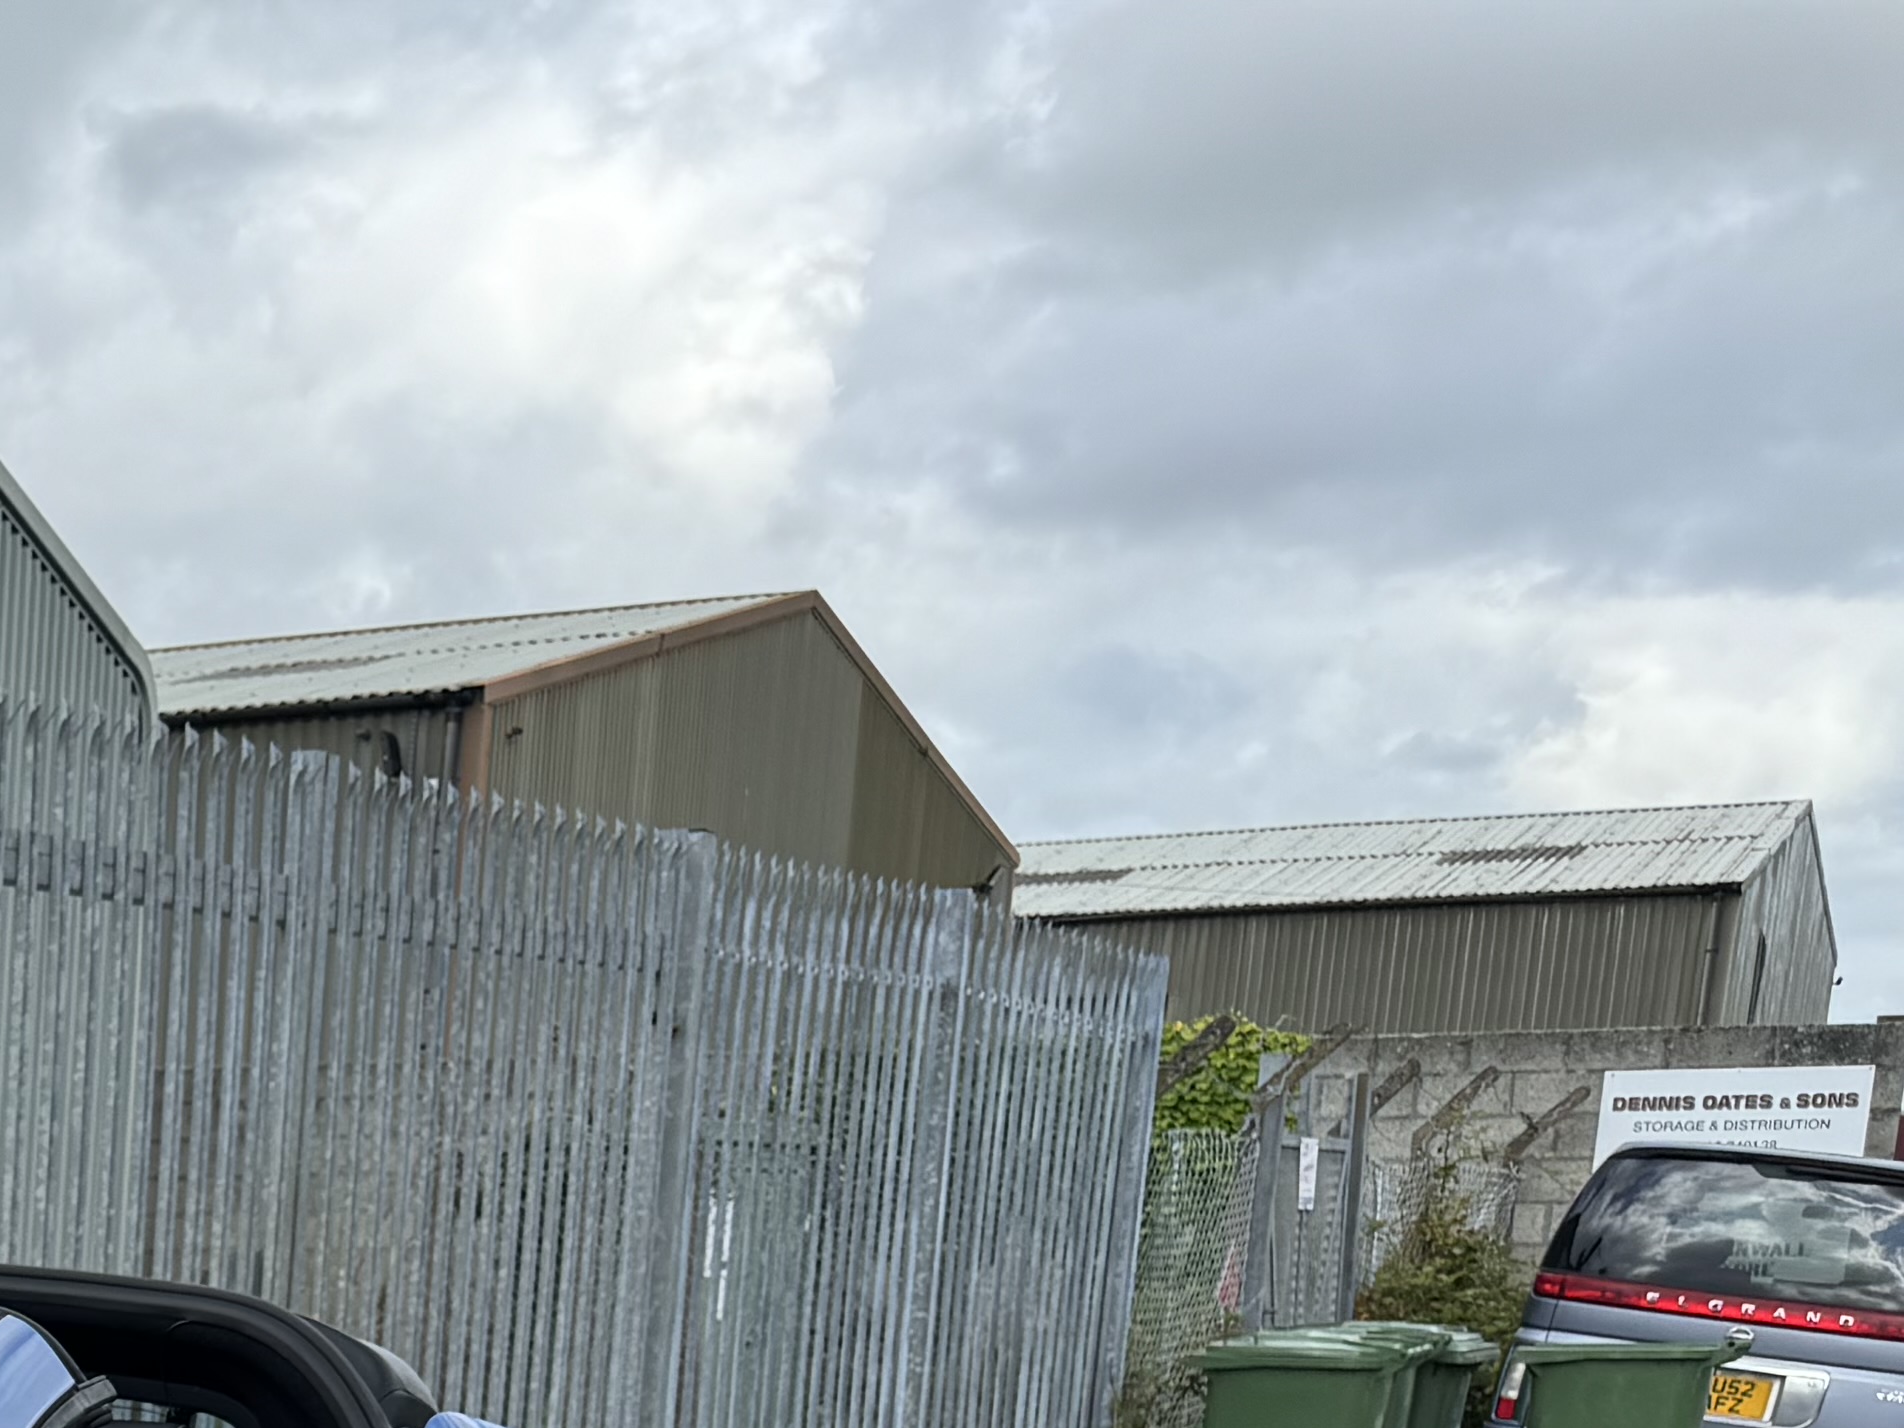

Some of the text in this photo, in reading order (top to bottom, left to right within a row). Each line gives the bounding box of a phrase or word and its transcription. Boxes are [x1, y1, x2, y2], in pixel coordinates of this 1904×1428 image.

[1612, 1092, 1860, 1112] DENNIS OATES & SONS
[1632, 1120, 1705, 1133] STORAGE
[1723, 1118, 1831, 1132] DISTRIBUTION
[1645, 1291, 1855, 1327] ELGRAND
